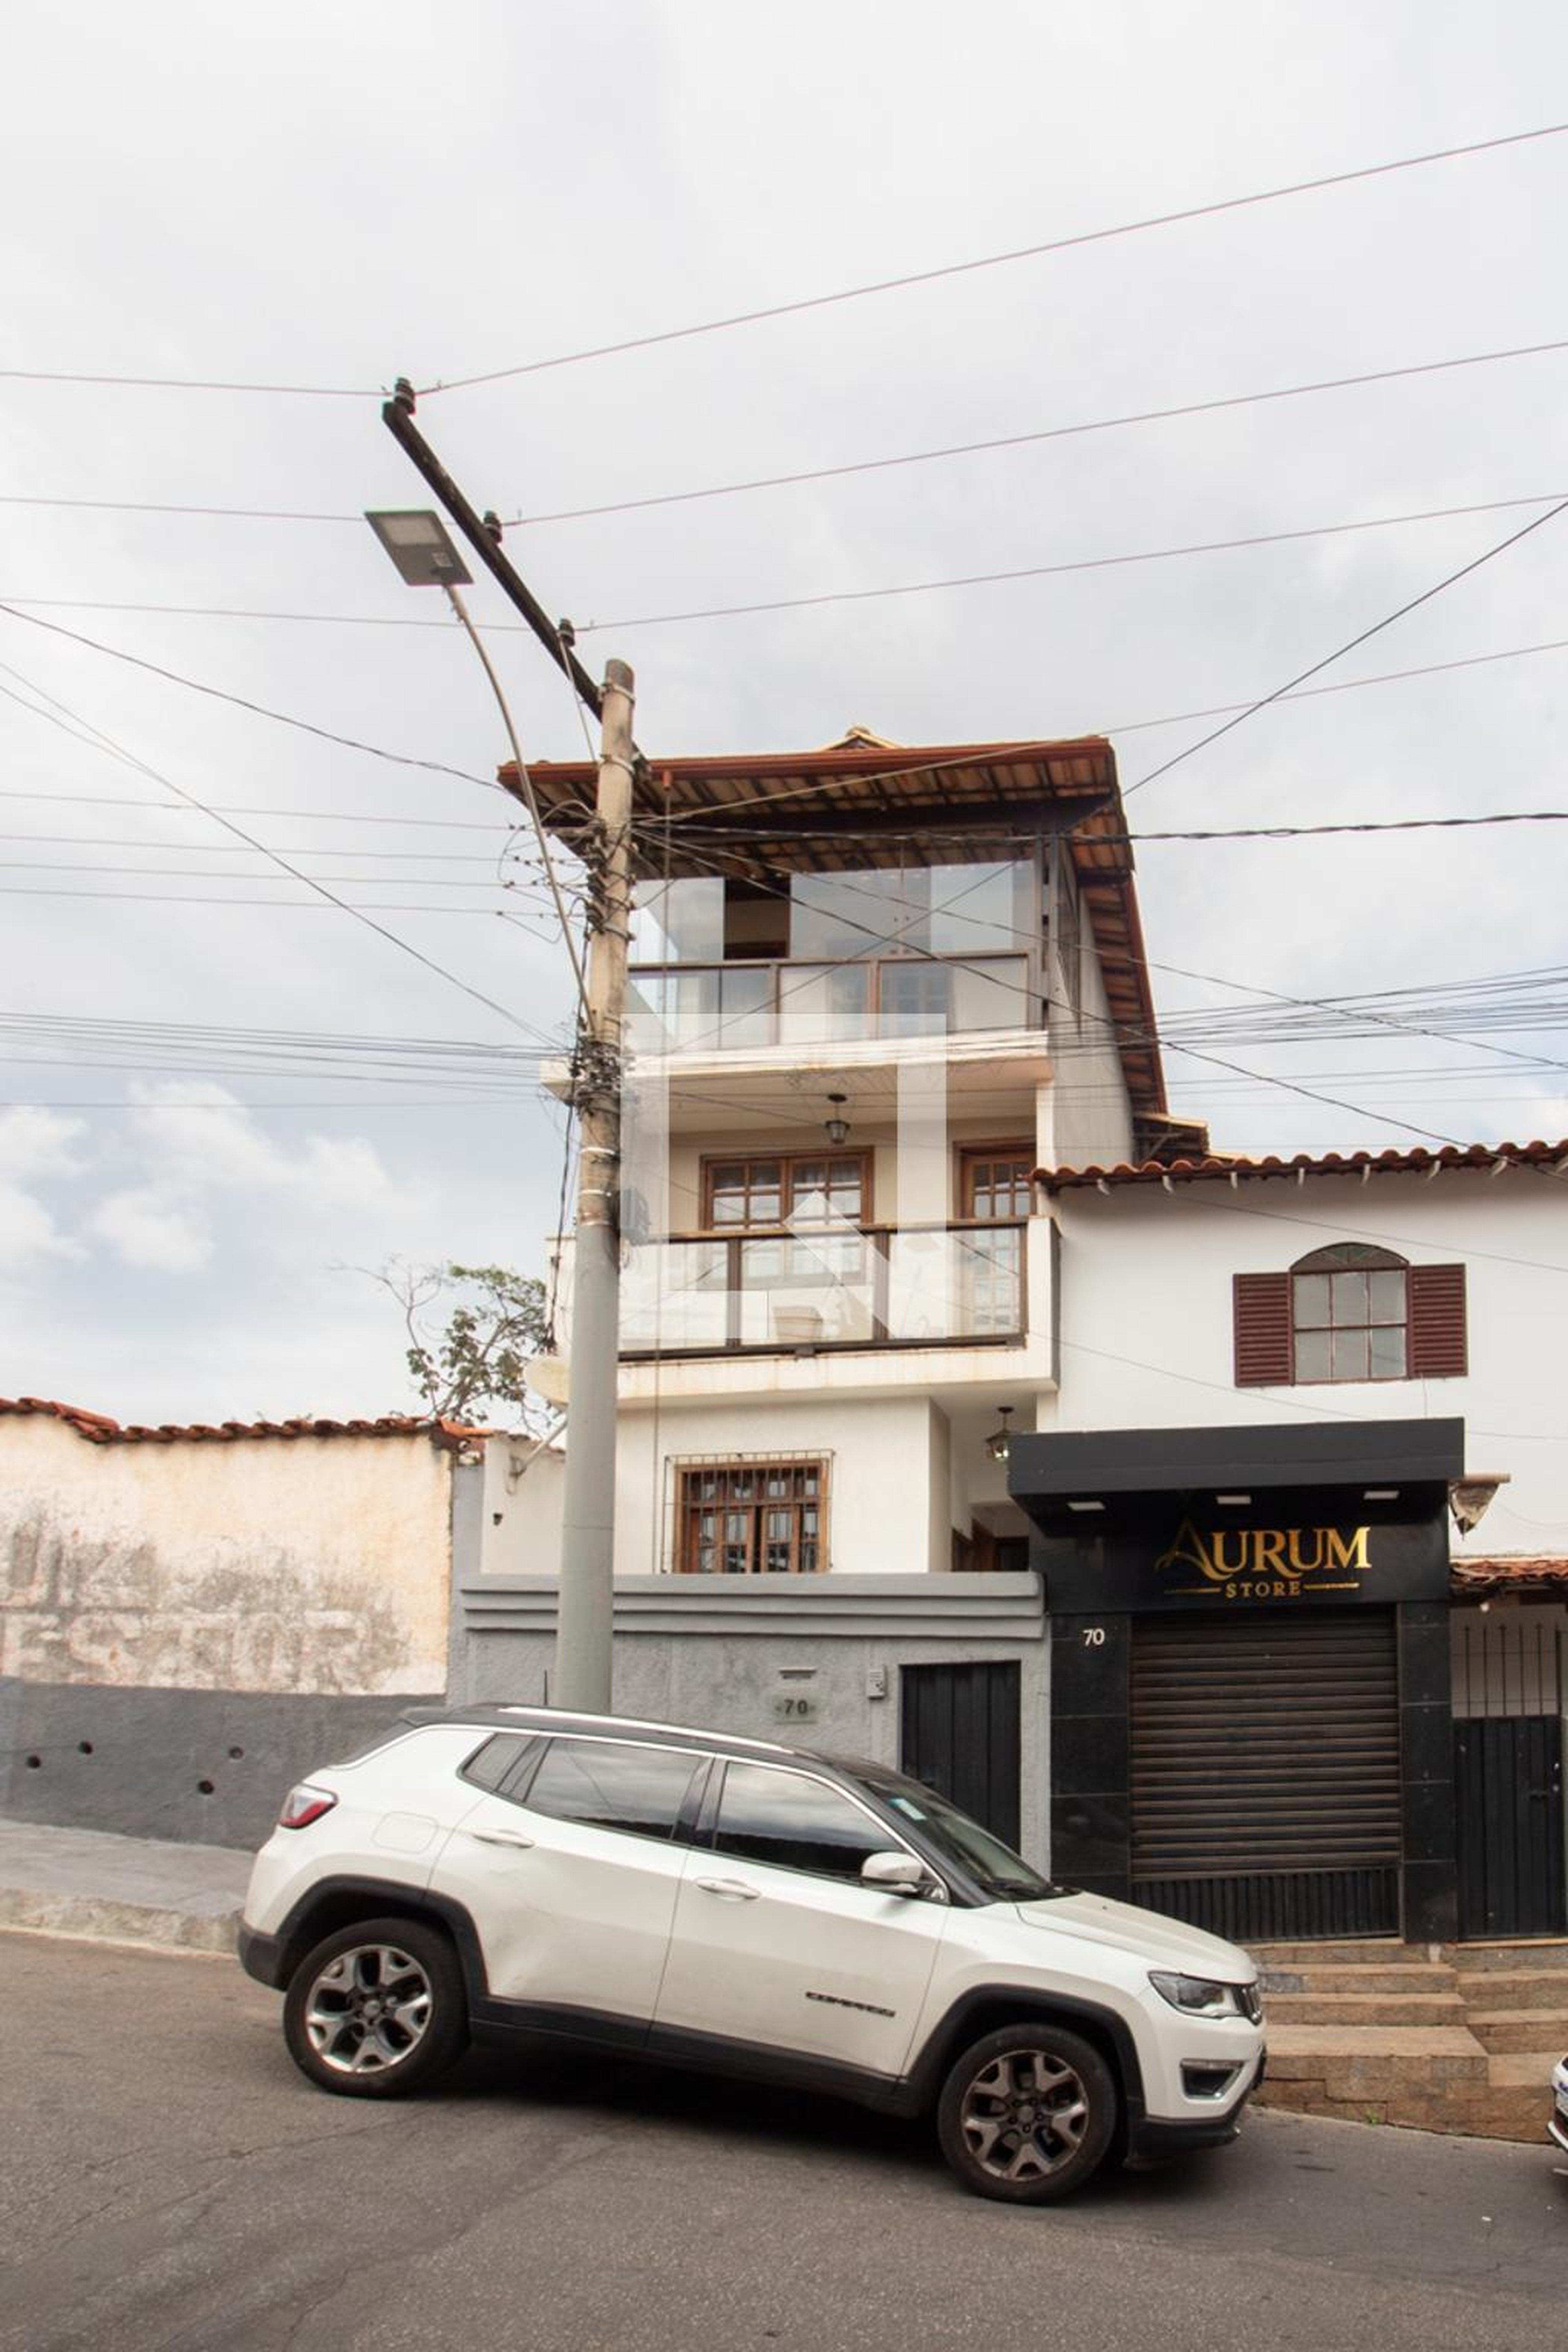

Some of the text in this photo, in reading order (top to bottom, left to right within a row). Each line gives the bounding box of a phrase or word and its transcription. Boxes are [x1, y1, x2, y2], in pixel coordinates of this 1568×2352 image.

[1155, 1517, 1372, 1581] AURUM
[1225, 1581, 1300, 1598] STORE
[1082, 1628, 1105, 1646] 70
[784, 1699, 808, 1715] 70
